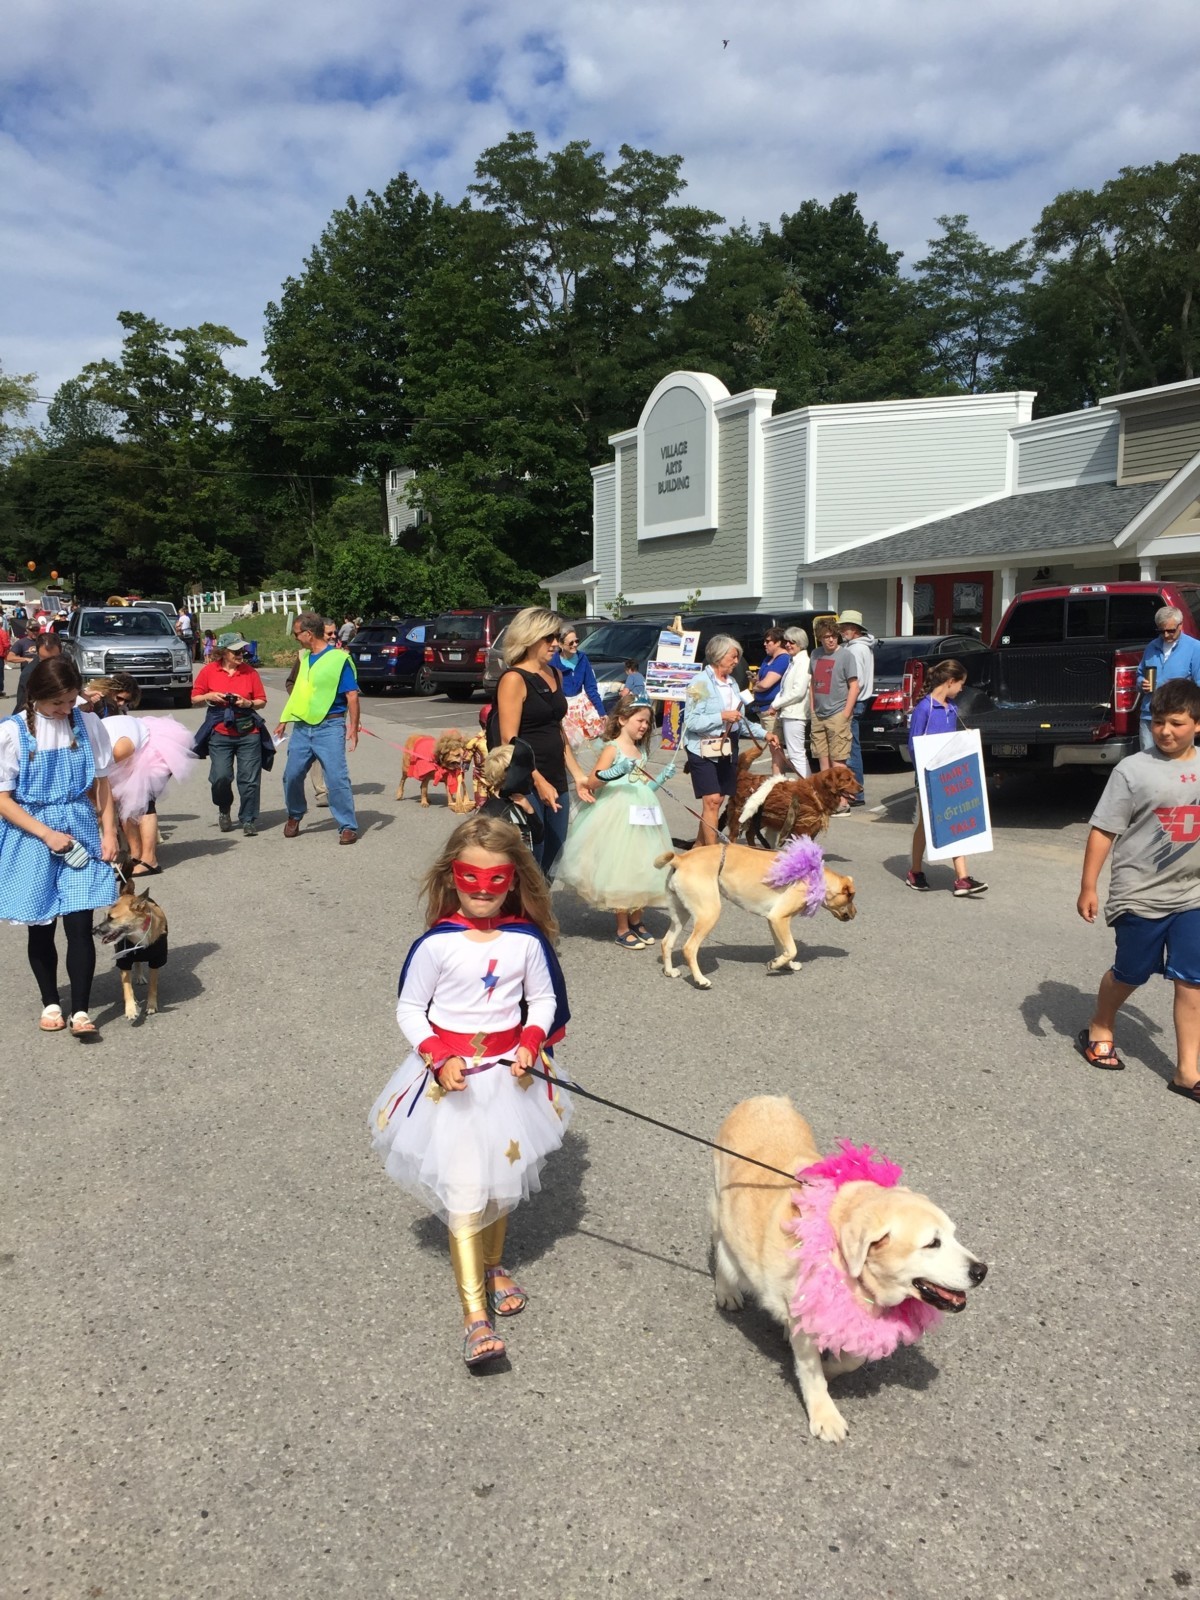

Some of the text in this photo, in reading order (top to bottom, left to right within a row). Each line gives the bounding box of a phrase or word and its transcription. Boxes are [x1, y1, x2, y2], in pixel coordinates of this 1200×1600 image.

[660, 441, 688, 459] VILLAGE
[665, 460, 682, 476] ARTS
[658, 475, 690, 495] BUILDING
[939, 762, 969, 784] HAIRY
[944, 797, 980, 820] Grimm
[950, 817, 977, 836] TALE
